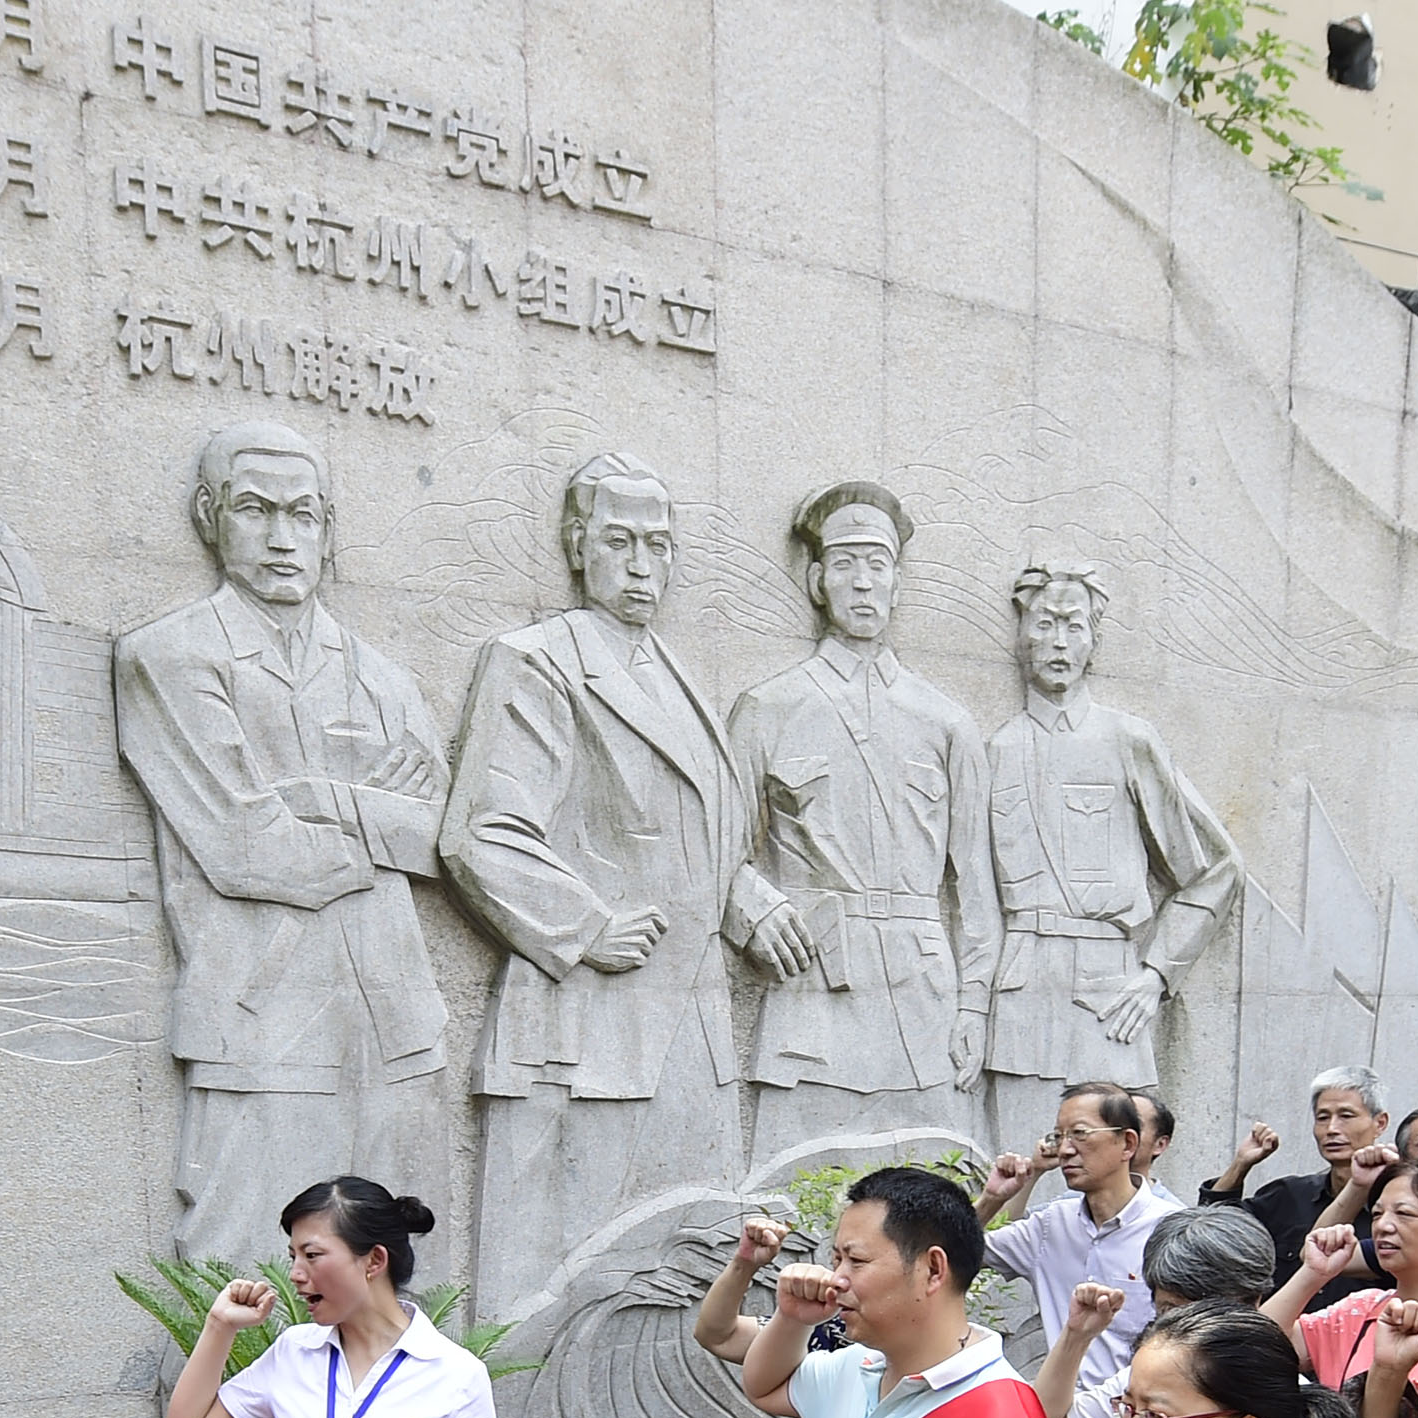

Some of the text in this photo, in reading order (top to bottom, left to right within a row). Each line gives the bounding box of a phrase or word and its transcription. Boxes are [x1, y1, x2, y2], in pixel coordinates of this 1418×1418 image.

[113, 15, 654, 228] 中国共产党成立
[114, 157, 717, 355] 中共杭州小组成立
[116, 299, 437, 427] 杭州解放
